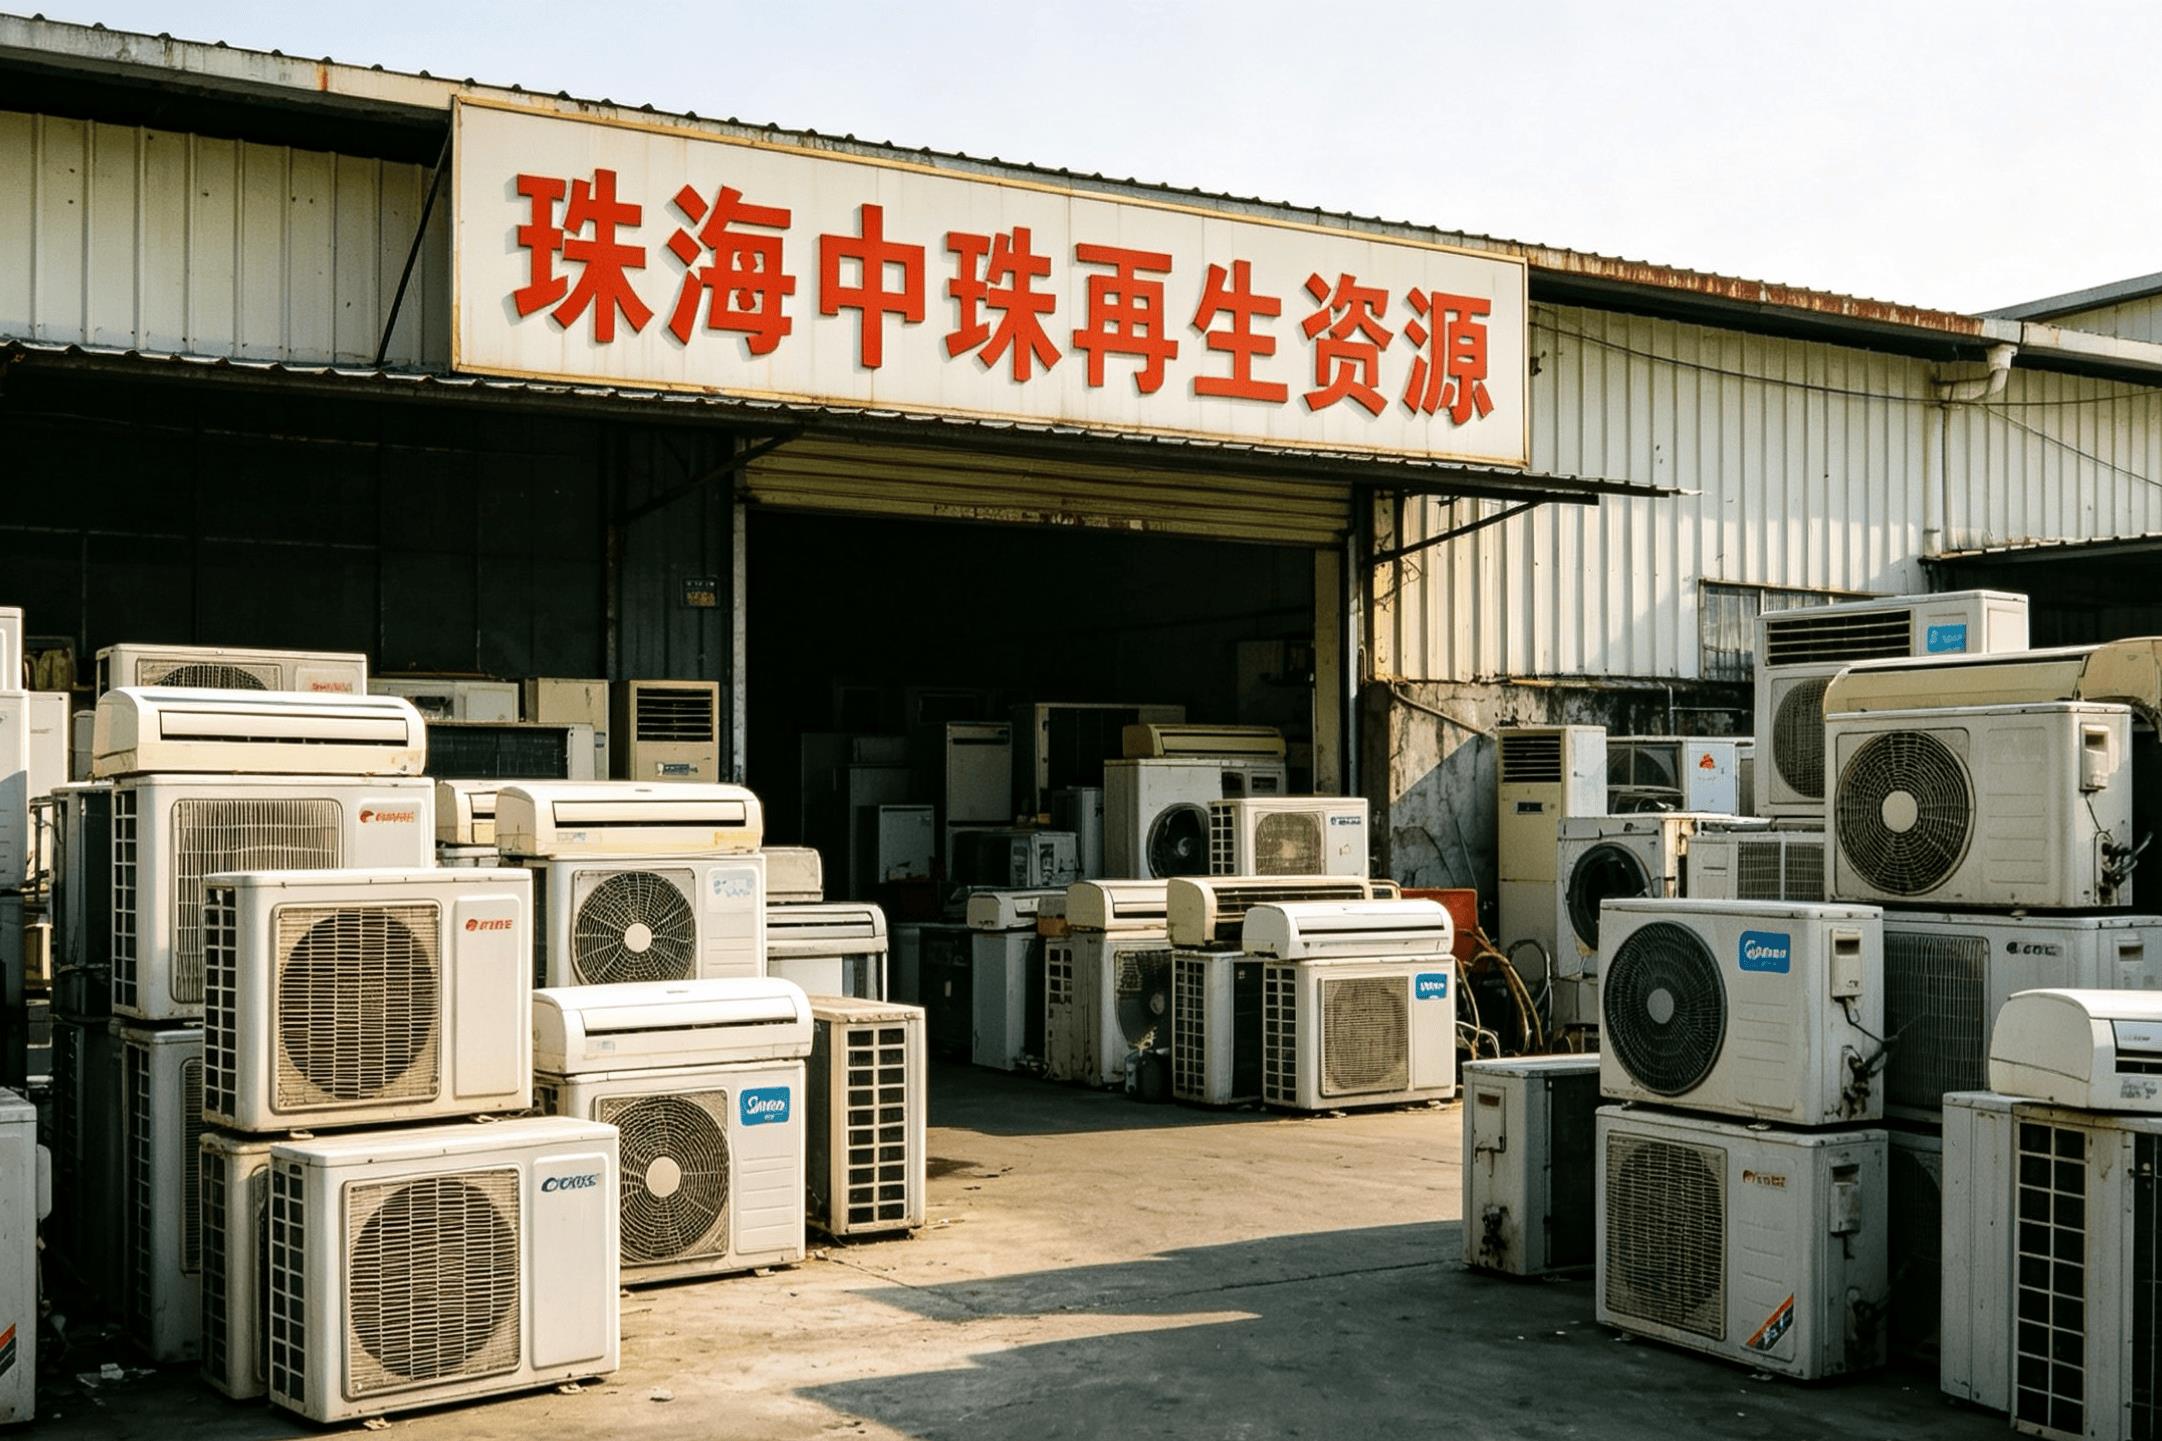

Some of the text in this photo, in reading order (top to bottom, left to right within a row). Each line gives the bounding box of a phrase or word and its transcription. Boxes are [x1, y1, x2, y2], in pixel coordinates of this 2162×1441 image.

[514, 168, 1494, 426] 珠海中珠再生资源
